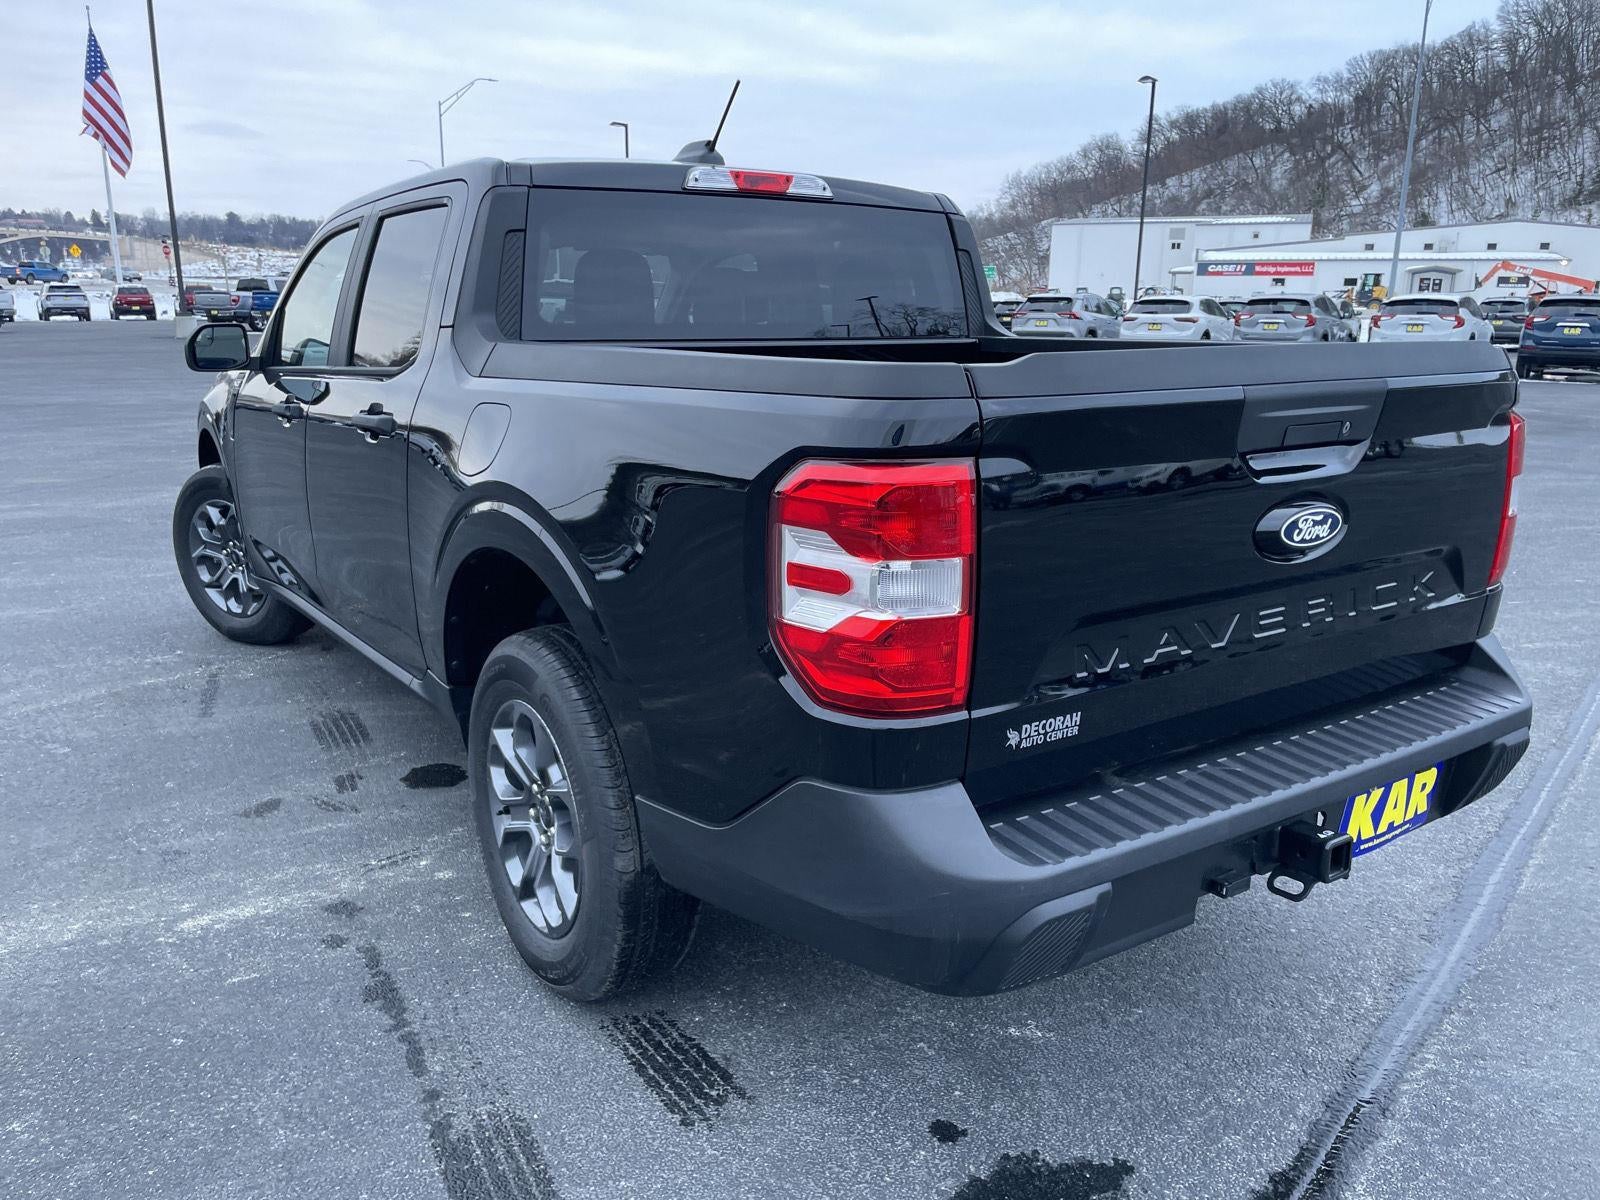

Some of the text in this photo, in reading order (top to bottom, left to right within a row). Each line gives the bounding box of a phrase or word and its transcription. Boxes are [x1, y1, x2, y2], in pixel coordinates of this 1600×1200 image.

[1293, 514, 1332, 542] Ford
[1075, 571, 1436, 678] MAVERICK
[1020, 726, 1080, 749] AUTO CENTER
[1021, 711, 1082, 739] DECORAH
[1346, 767, 1438, 843] KAR
